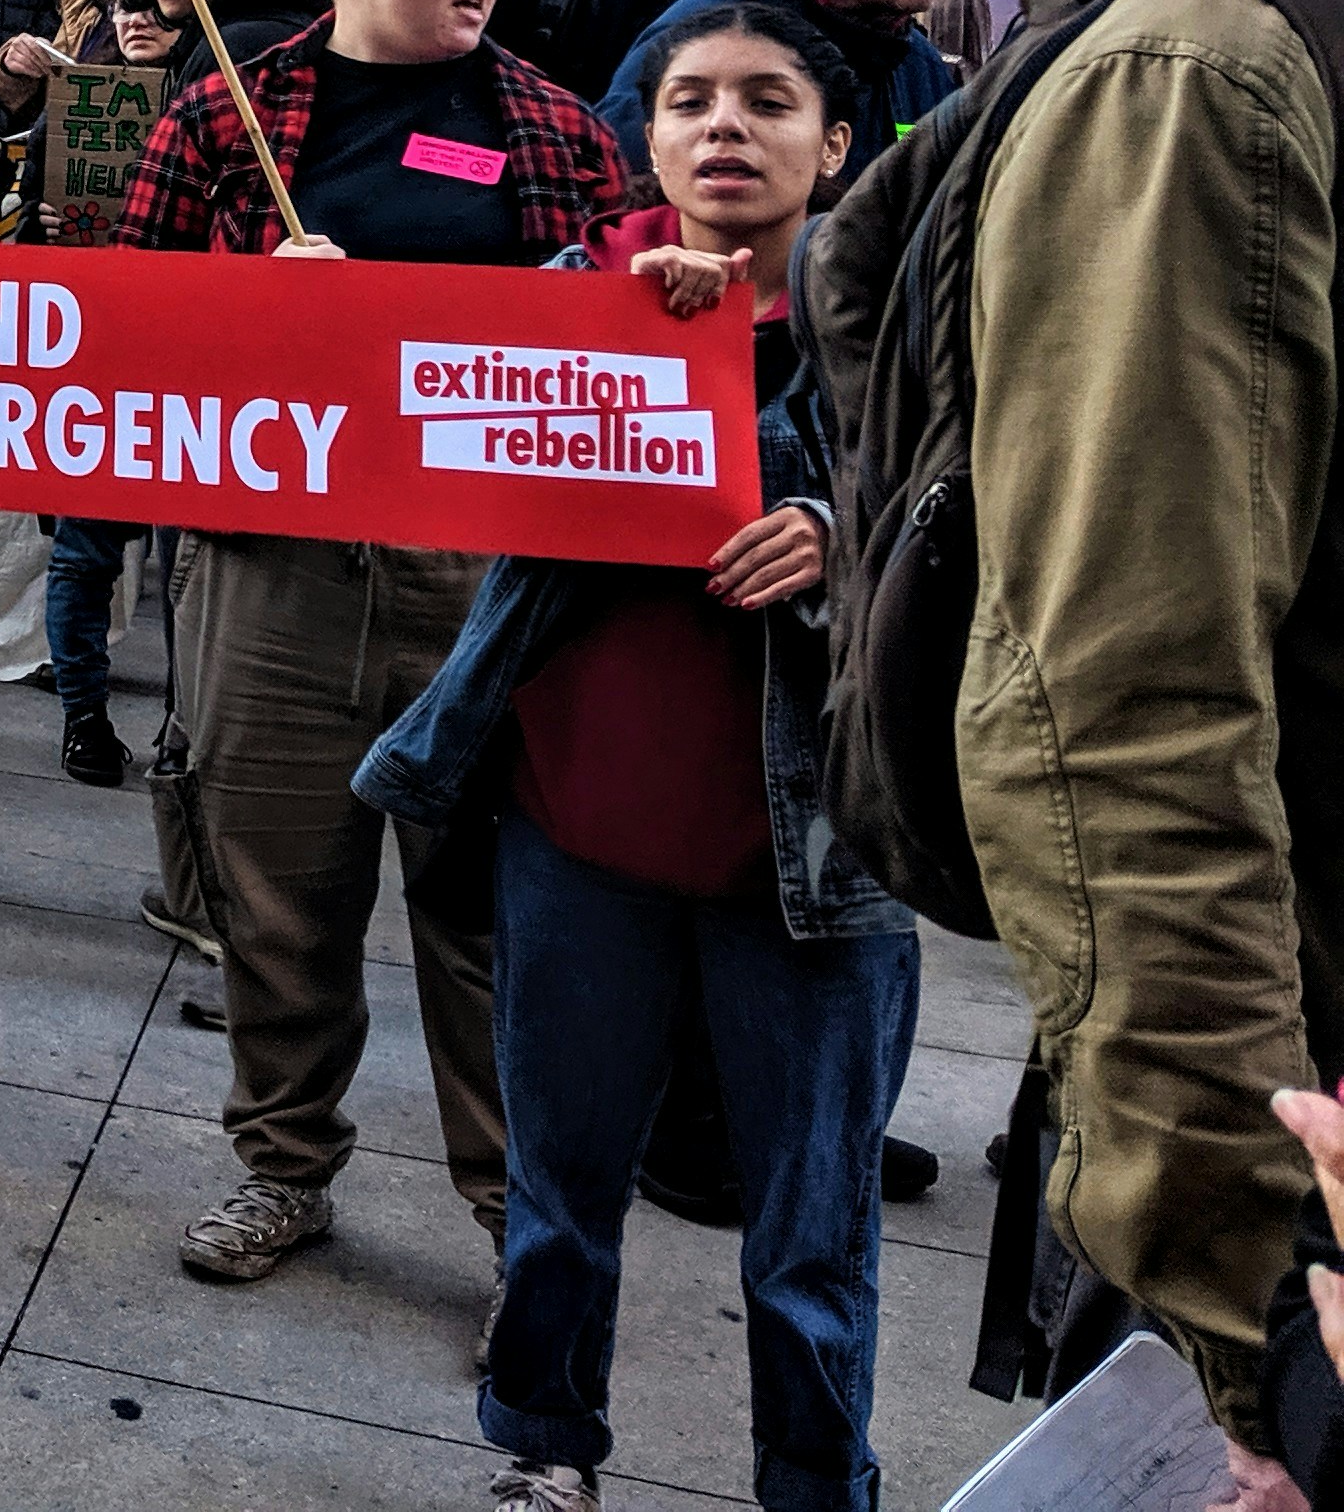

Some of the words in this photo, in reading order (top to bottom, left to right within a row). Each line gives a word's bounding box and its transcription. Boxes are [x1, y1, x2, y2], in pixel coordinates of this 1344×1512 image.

[67, 73, 151, 117] I'M
[63, 119, 153, 152] TIR
[413, 350, 648, 409] extinction
[484, 407, 705, 478] rebellion
